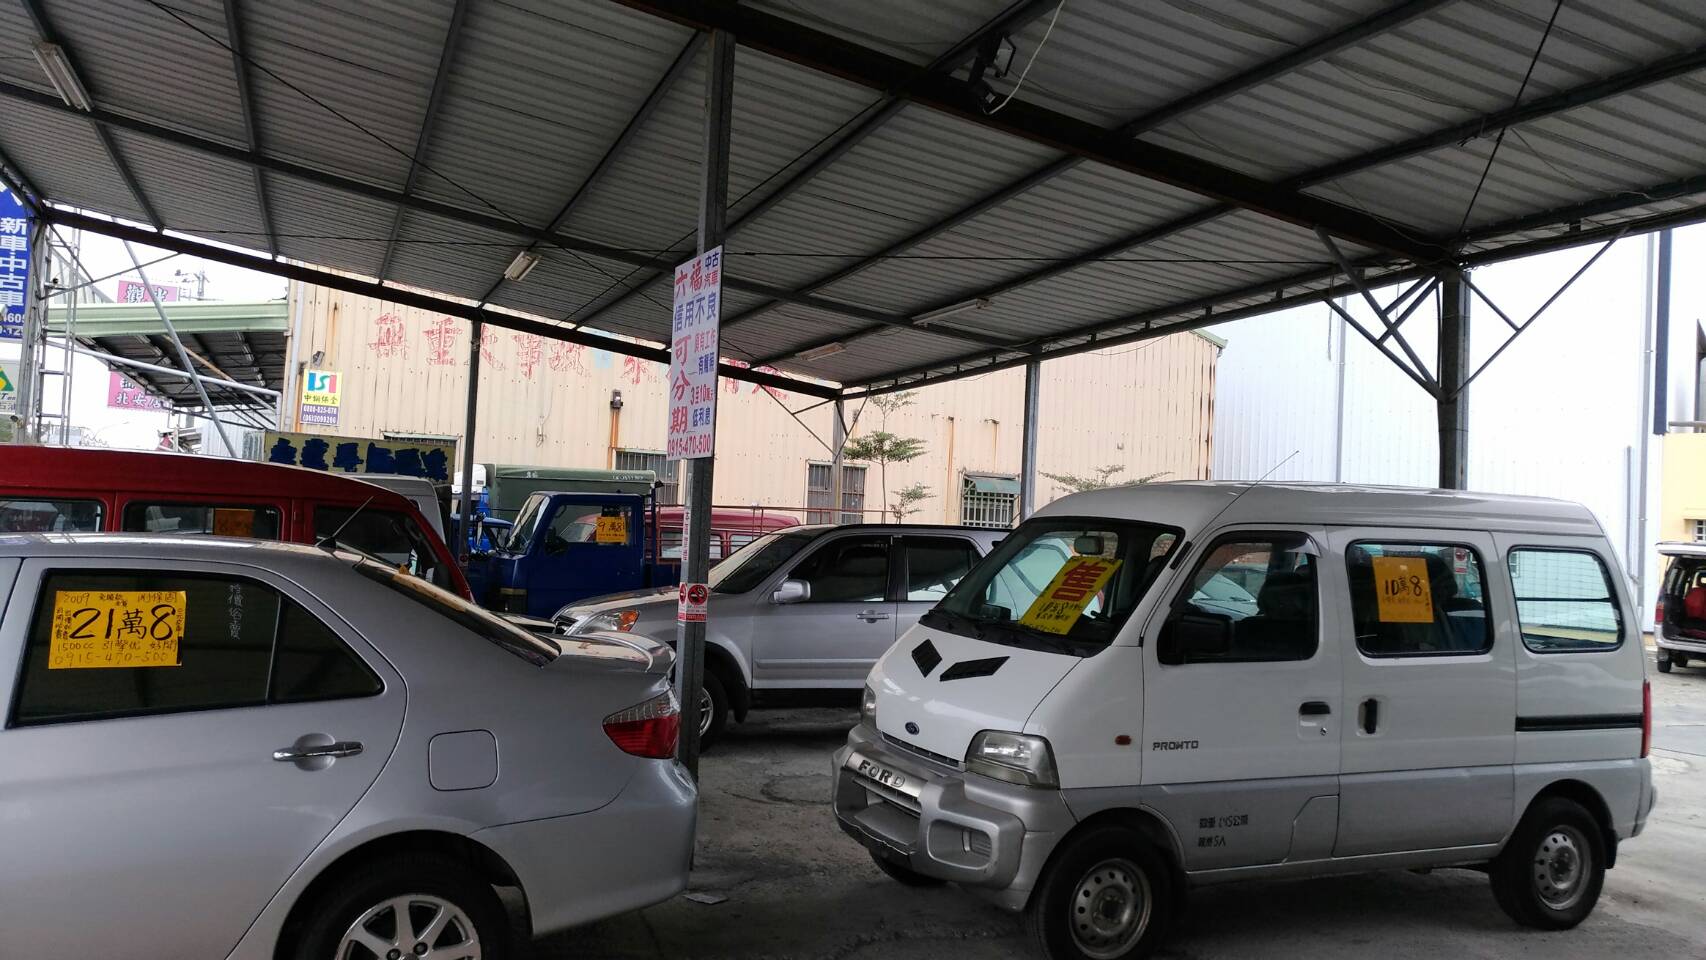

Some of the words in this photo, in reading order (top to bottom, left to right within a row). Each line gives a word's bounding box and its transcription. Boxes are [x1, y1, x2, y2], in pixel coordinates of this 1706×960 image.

[705, 251, 720, 270] 中古
[676, 260, 703, 297] 六福
[704, 269, 719, 290] 汽車
[674, 291, 717, 333] 信用不良
[670, 334, 692, 435] 可分期
[667, 433, 711, 457] 0915-470-500
[68, 603, 177, 641] 21萬8
[1152, 740, 1199, 751] PRONTO
[857, 759, 906, 788] FORD
